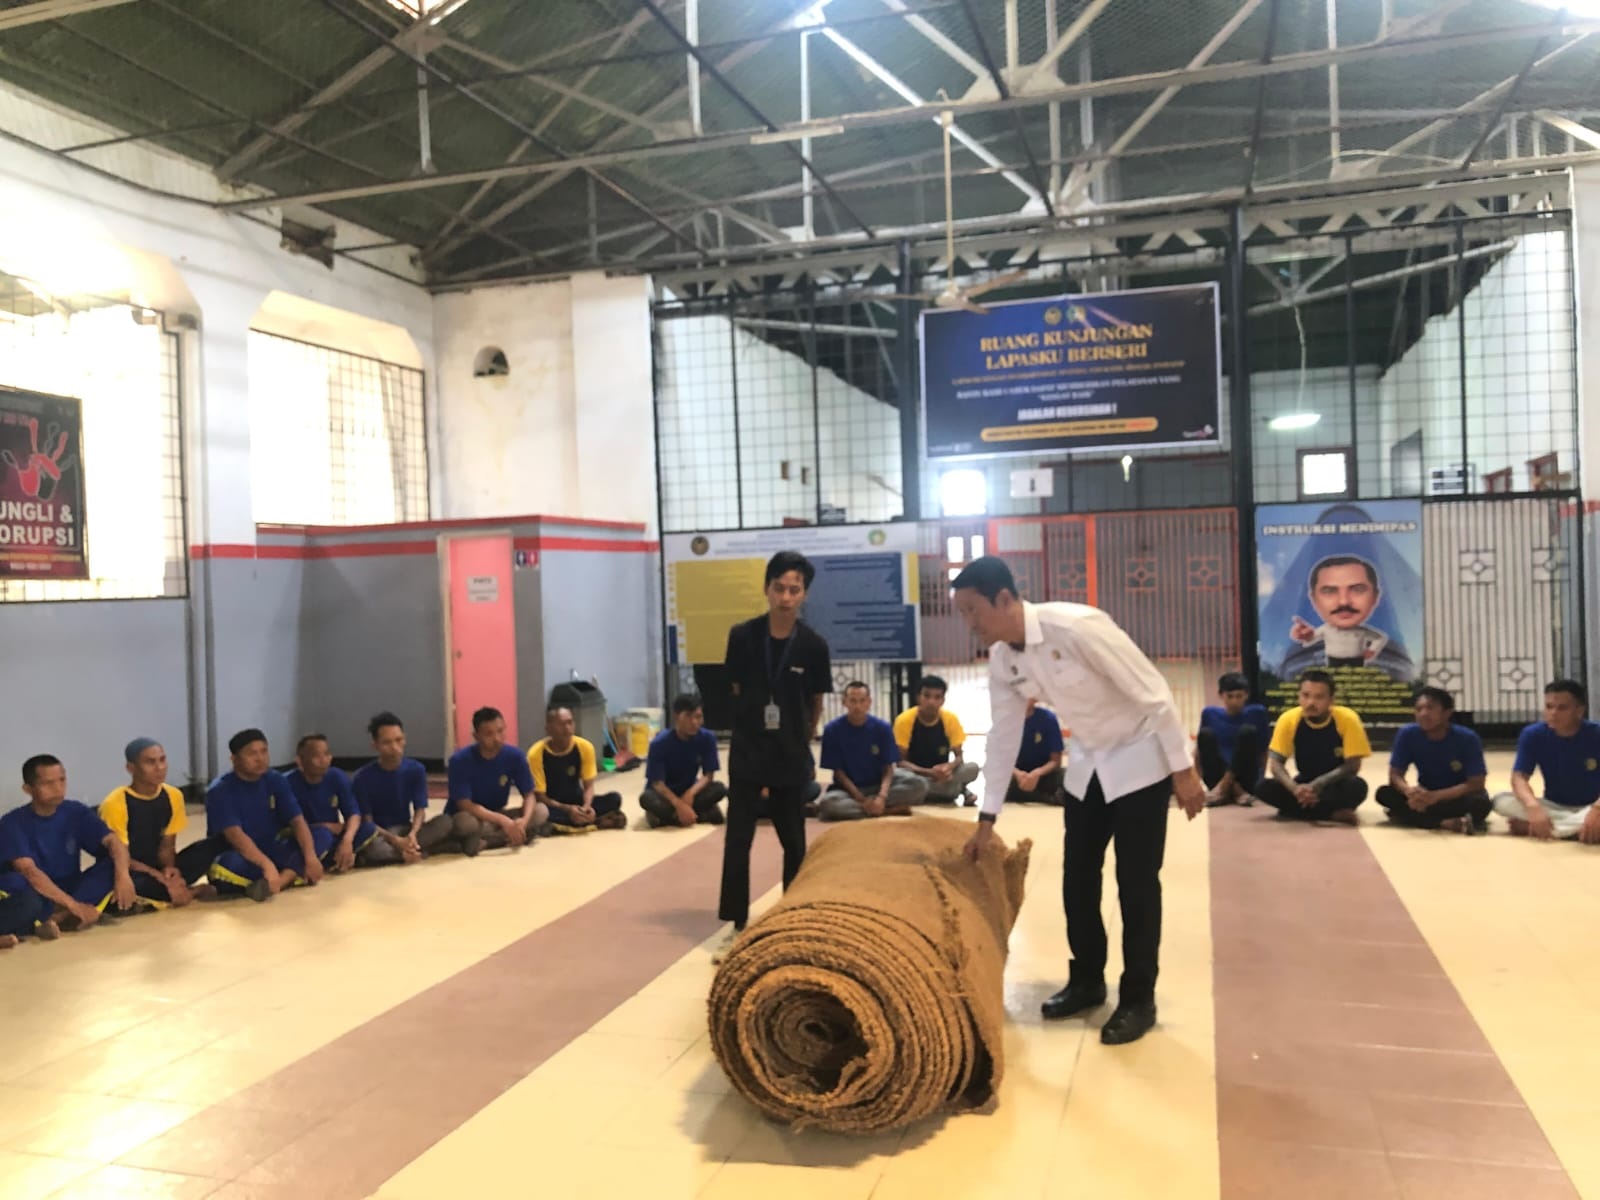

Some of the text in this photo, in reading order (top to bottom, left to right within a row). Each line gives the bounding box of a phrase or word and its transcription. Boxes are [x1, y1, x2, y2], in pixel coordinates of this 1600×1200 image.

[980, 324, 1153, 352] RUANG KUNJUNGAN
[986, 349, 1063, 371] LAPASKU
[1067, 343, 1148, 363] BERSERI
[60, 504, 74, 523] &
[1263, 523, 1336, 536] INSTRUKSI
